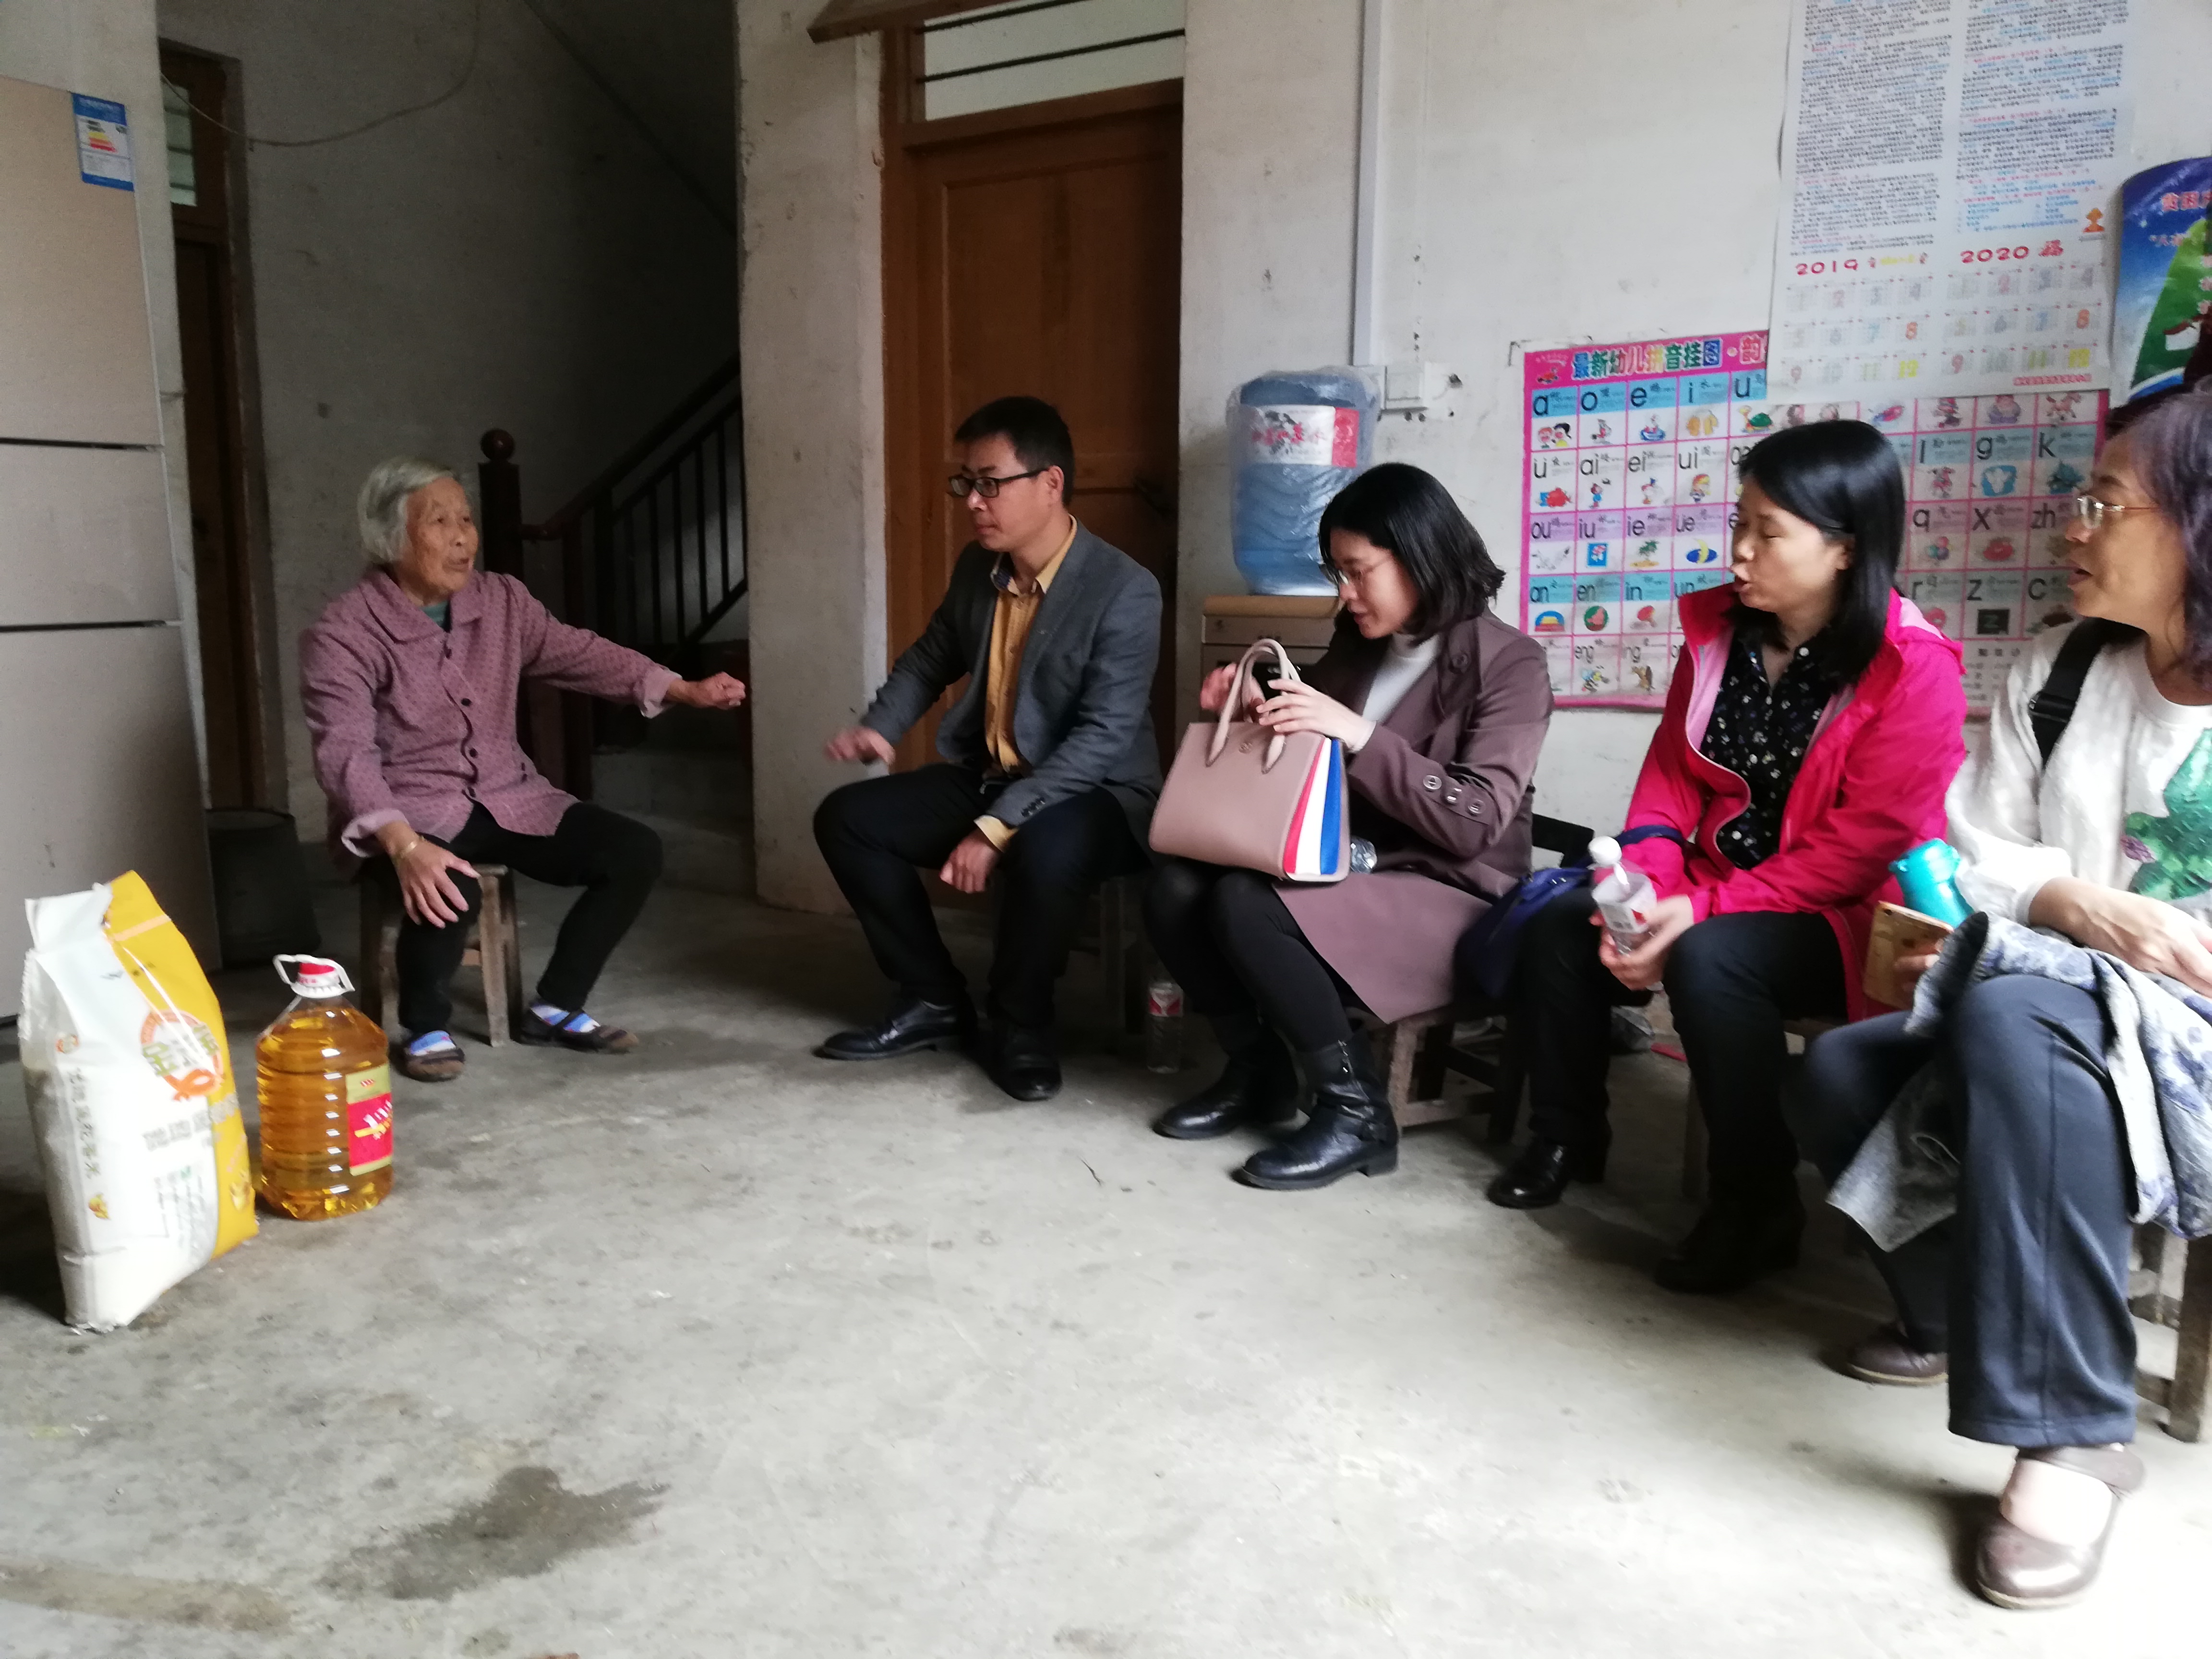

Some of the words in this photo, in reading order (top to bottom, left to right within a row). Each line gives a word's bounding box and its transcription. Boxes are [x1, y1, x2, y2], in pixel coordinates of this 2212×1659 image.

[1960, 246, 2030, 264] 2020
[1795, 259, 1859, 275] 2019
[1905, 321, 1918, 340] 8
[1898, 359, 1919, 378] 12
[1533, 395, 1549, 416] a
[1581, 391, 1598, 411] o
[1631, 388, 1647, 407] e
[1688, 381, 1694, 404] i
[1734, 376, 1750, 398] u
[1976, 436, 1993, 460] g
[2038, 432, 2056, 458] k
[1580, 453, 1599, 475] ai
[1628, 451, 1647, 472] ei
[1678, 447, 1698, 469] ui
[1912, 509, 1930, 532] q
[2030, 503, 2056, 529] zh
[1531, 520, 1551, 540] ou
[1579, 518, 1596, 539] iu
[1627, 518, 1646, 536] ie
[1530, 585, 1550, 603] an
[1576, 584, 1596, 602] en
[1625, 581, 1643, 601] in
[1911, 580, 1923, 600] r
[1575, 645, 1595, 664] eng
